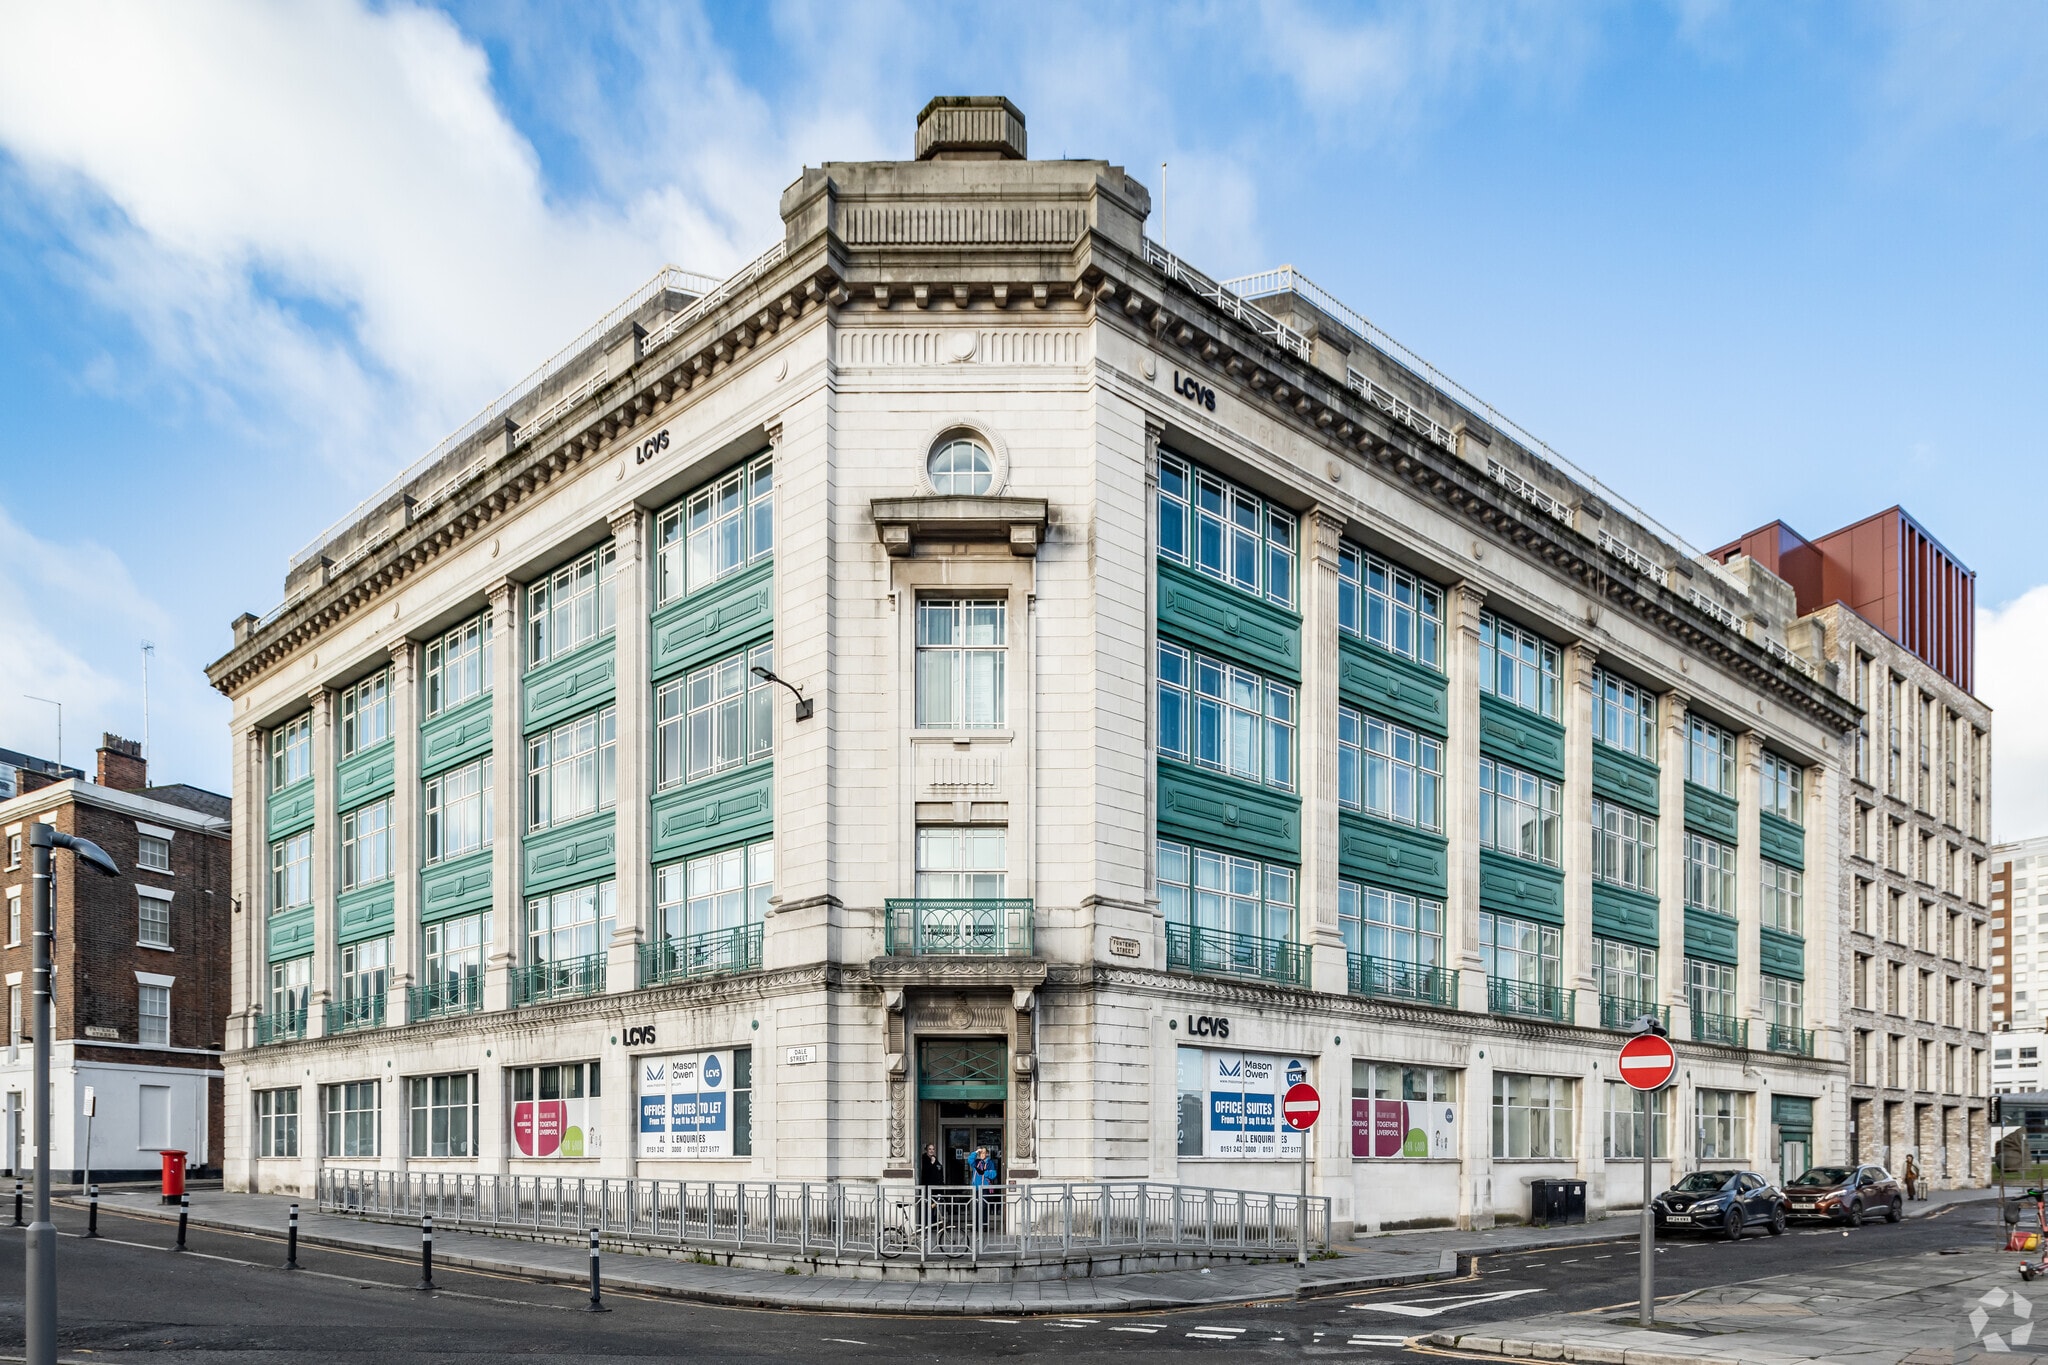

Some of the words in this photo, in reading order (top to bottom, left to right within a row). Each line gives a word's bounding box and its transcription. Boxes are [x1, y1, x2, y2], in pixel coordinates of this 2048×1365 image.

[1174, 370, 1215, 411] LCVS
[637, 429, 669, 465] LCVS
[1113, 939, 1137, 948] FONTENOY
[1188, 1014, 1229, 1038] LCVS
[622, 1025, 656, 1046] LCVS
[672, 1061, 697, 1070] Mason
[1245, 1060, 1272, 1070] Mason
[672, 1071, 694, 1079] Owen
[705, 1069, 720, 1077] LCVS
[1245, 1069, 1269, 1079] Owen
[1289, 1073, 1302, 1082] LCVS
[644, 1104, 666, 1116] OFFICE
[673, 1103, 696, 1115] SUITES
[699, 1102, 708, 1114] TO
[709, 1101, 721, 1113] LET
[1215, 1101, 1242, 1113] OFFICE
[1246, 1102, 1272, 1114] SUITES
[649, 1117, 660, 1125] From
[1221, 1116, 1234, 1124] From
[1248, 1118, 1255, 1126] sq
[1255, 1117, 1260, 1125] ft
[1260, 1117, 1266, 1125] to
[1376, 1120, 1399, 1128] TOGETHER
[539, 1128, 558, 1136] LIVERPOOL
[1376, 1129, 1399, 1137] LIVERPOOL
[659, 1135, 675, 1143] ALL
[676, 1134, 706, 1144] ENQUIRIES
[1236, 1134, 1249, 1143] ALL
[1250, 1134, 1287, 1144] ENQUIRIES
